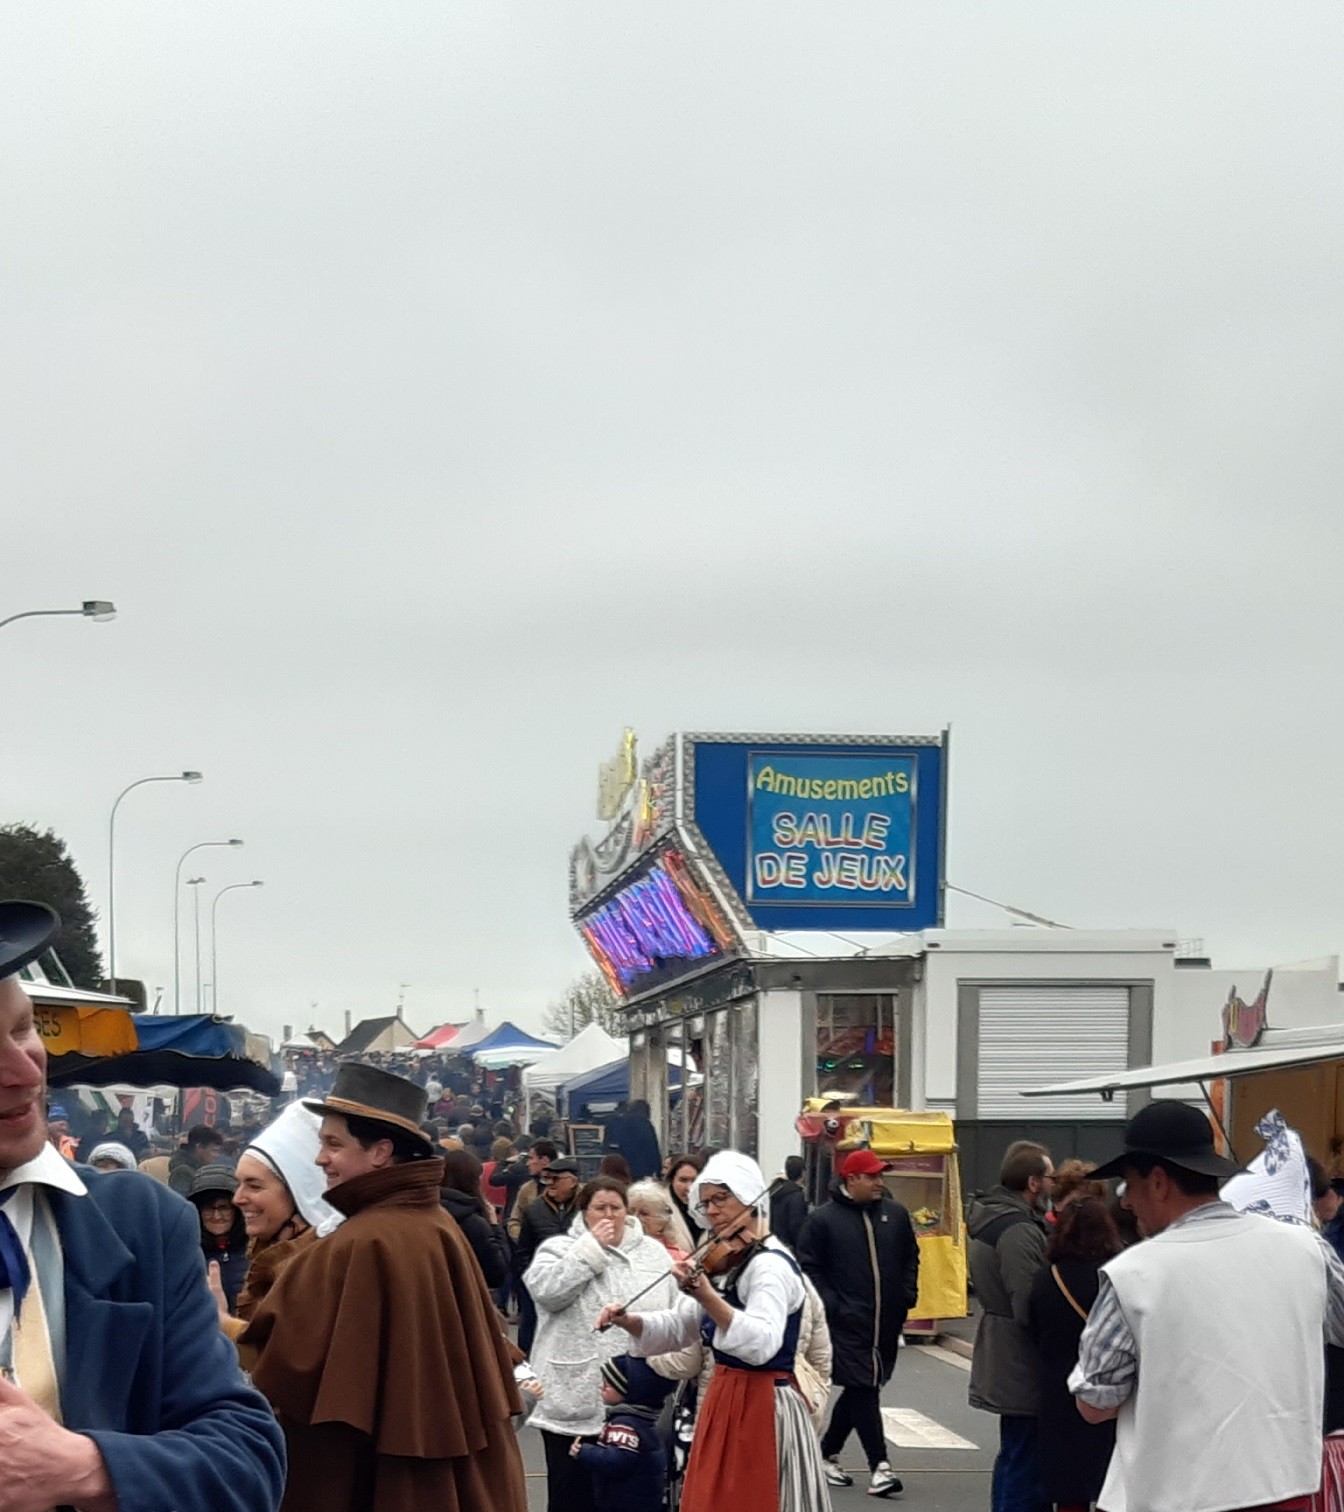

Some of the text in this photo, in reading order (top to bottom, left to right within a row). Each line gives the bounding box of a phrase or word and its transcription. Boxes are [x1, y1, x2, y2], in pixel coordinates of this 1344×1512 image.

[756, 765, 909, 800] Amusements
[772, 812, 891, 850] SALLE
[756, 852, 906, 891] DE JEUX
